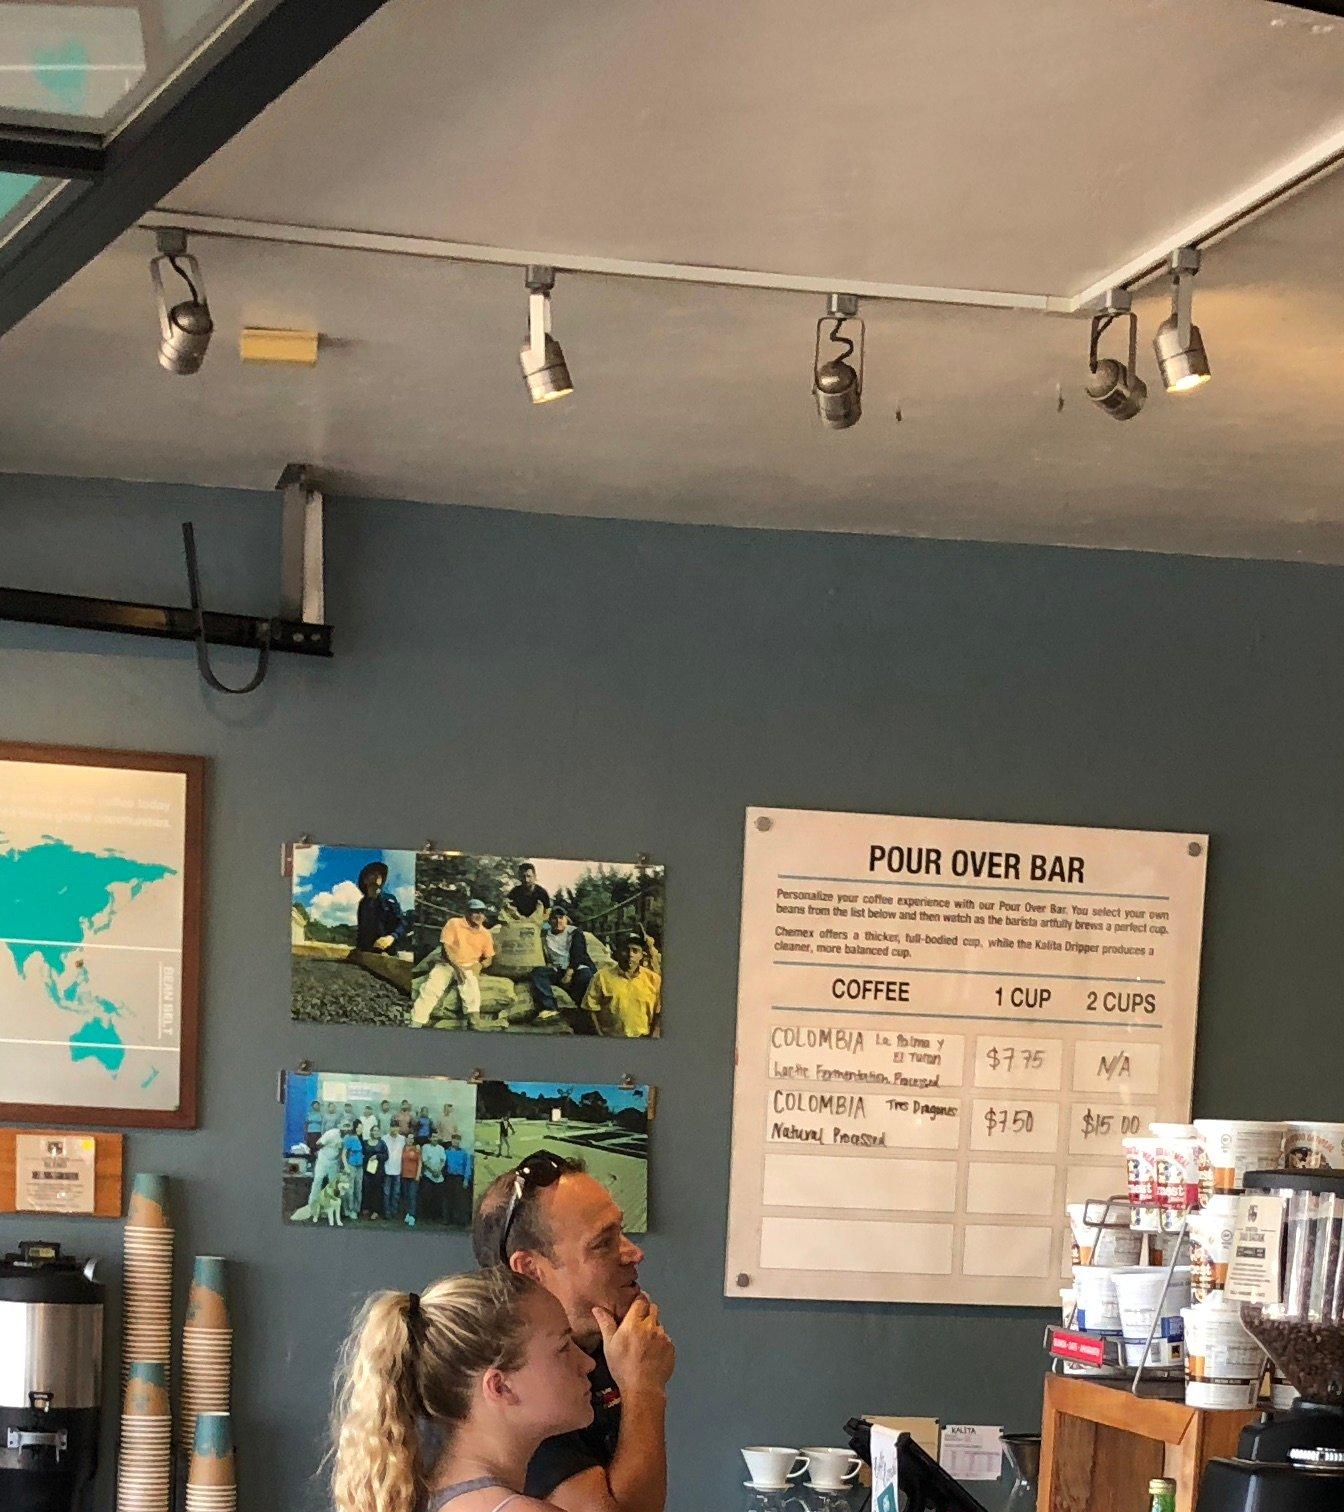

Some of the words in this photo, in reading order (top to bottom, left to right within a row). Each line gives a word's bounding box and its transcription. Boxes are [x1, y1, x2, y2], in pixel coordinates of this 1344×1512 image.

[869, 845, 942, 876] POUR
[951, 850, 1020, 880] OVER
[1030, 854, 1085, 884] BAR
[832, 978, 910, 1002] COFFEE
[995, 987, 1003, 1006] 1
[1010, 987, 1051, 1008] CUP
[1087, 991, 1098, 1011] 2
[1103, 991, 1156, 1014] CUPS
[771, 1027, 864, 1054] COLOMBIA
[773, 1090, 866, 1119] COLOMBIA
